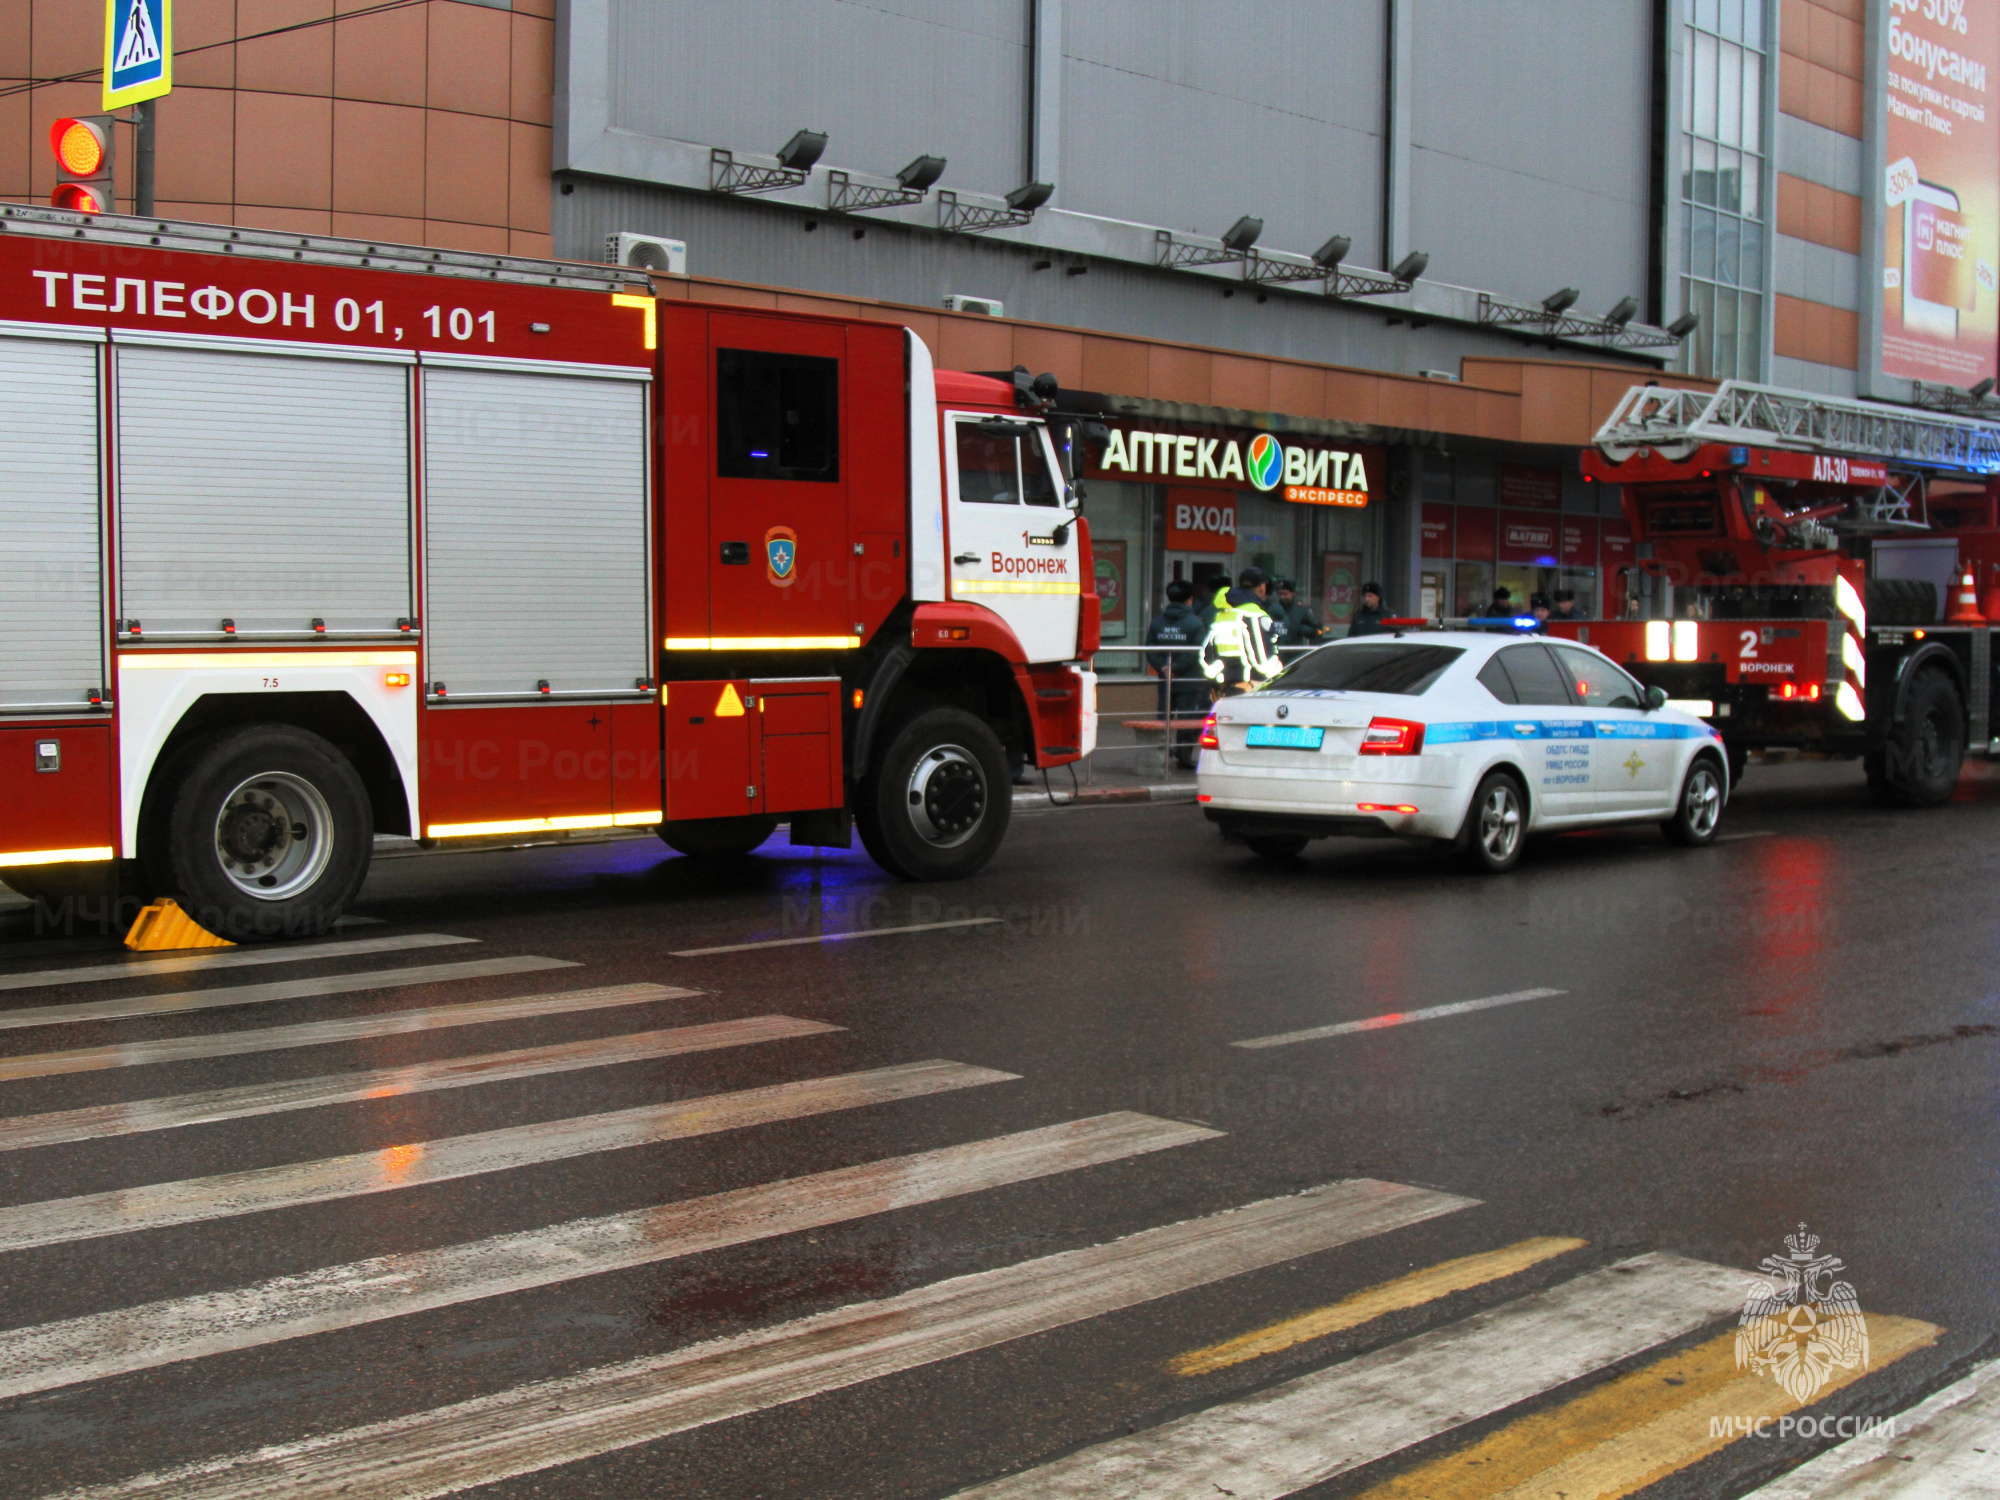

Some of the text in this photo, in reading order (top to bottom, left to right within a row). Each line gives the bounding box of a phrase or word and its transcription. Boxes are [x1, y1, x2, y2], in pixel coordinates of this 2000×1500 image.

[1888, 16, 1986, 92] бонусами
[1888, 71, 1985, 123] за покупки с картой
[1888, 94, 1953, 135] Магнит Плюс
[1888, 171, 1915, 196] -30%
[1936, 218, 1973, 241] магнит
[1936, 239, 1964, 260] плюс
[33, 269, 497, 343] ТЕЛЕФОН 01, 101
[1101, 429, 1369, 492] АПТЕКА ВИТА
[1813, 455, 1848, 484] АЛ-30
[1288, 488, 1365, 506] ЭКСПРЕСС
[1176, 504, 1236, 536] ВХОД
[1022, 530, 1029, 548] 1
[1509, 532, 1549, 544] МАГНИТ
[991, 551, 1068, 578] Воронеж
[1108, 580, 1117, 596] 2
[1740, 630, 1758, 658] 2
[1740, 663, 1795, 673] ВОРОНЕЖ
[262, 678, 279, 688] 7.5
[1569, 745, 1589, 755] ГИБДД
[1546, 760, 1589, 770] УМВД РОССИИ
